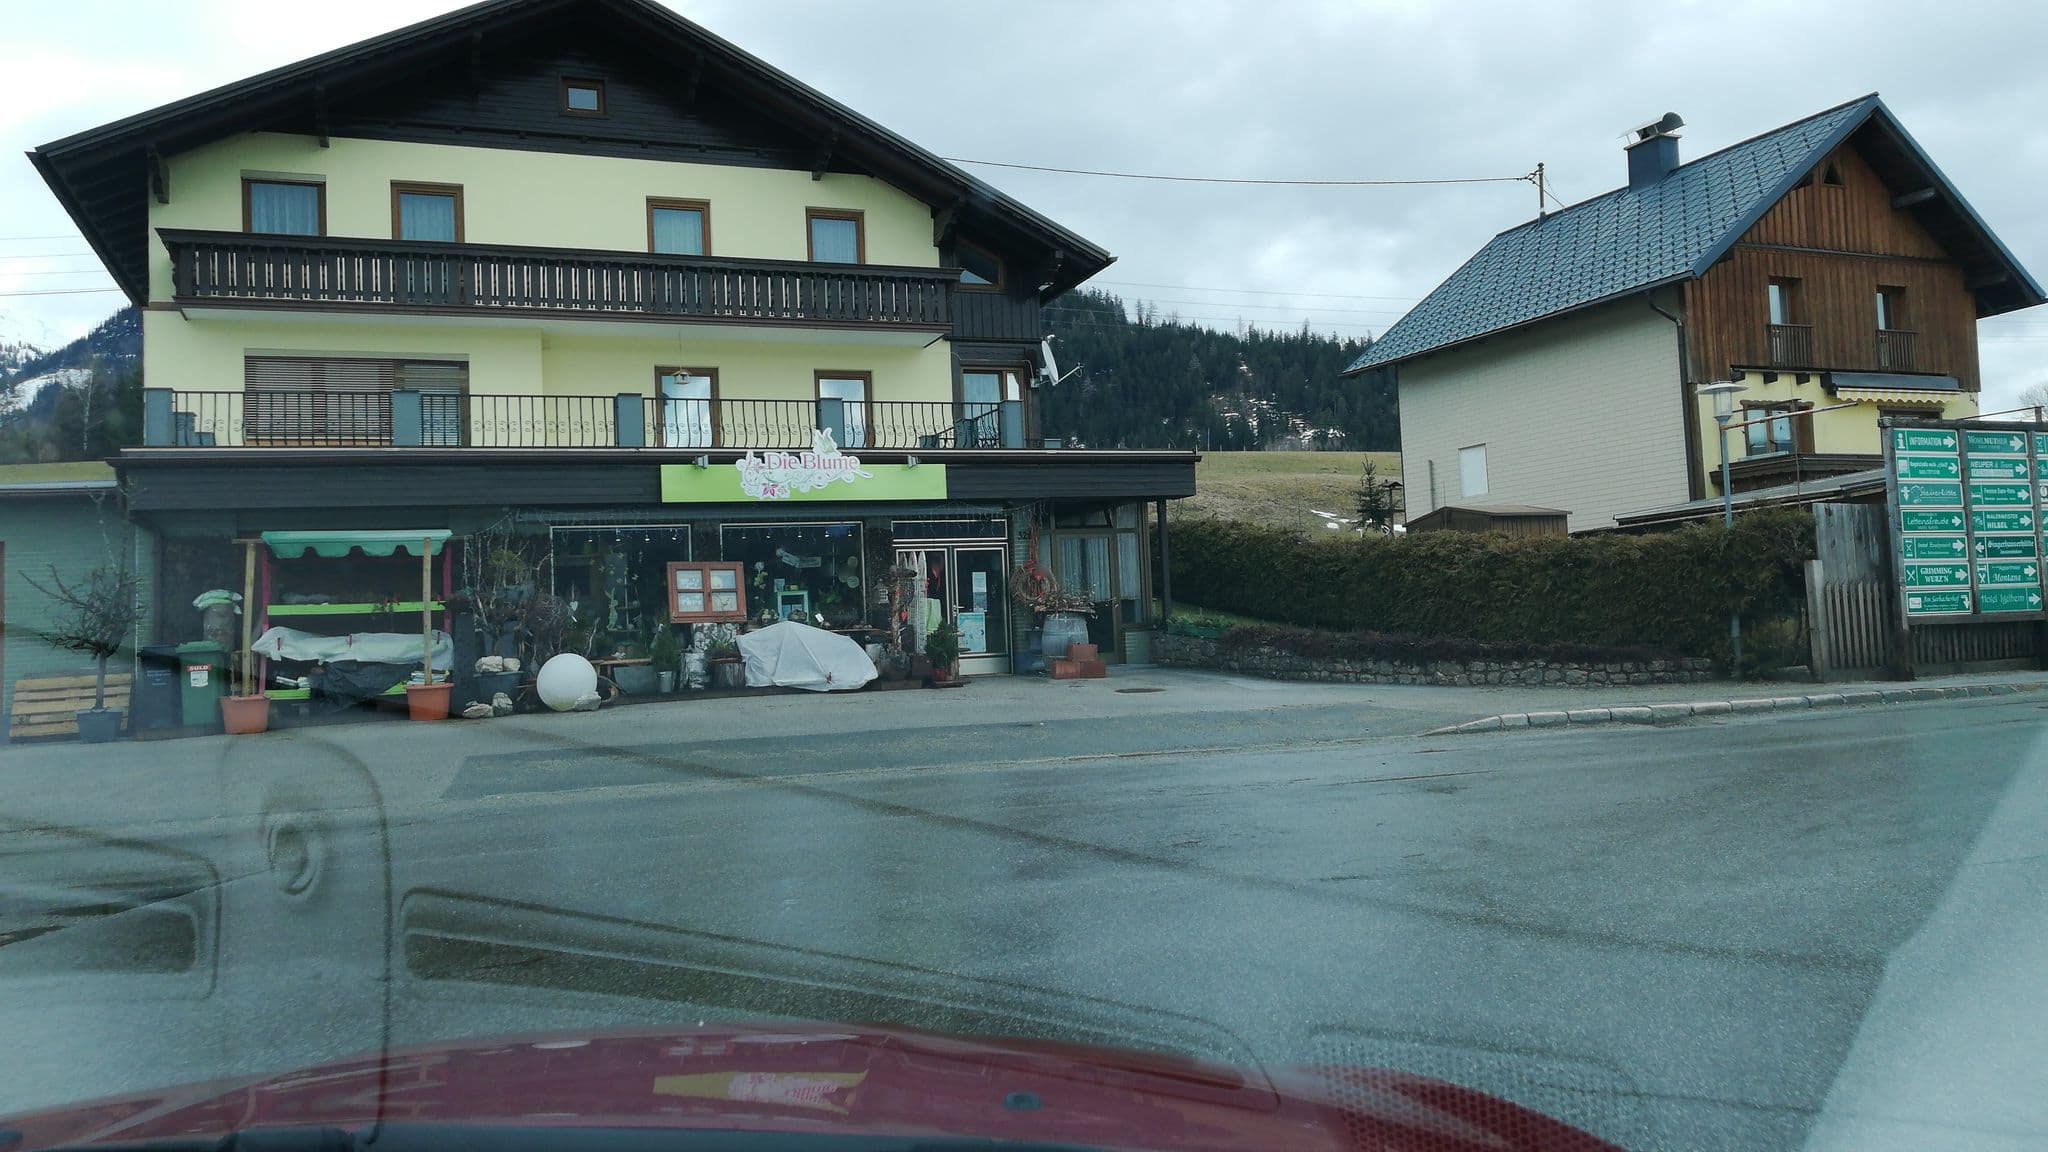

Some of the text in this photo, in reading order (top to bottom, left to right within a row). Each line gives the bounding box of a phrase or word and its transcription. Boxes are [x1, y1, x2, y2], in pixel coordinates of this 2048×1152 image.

[1908, 436, 1942, 446] INFORMATION
[767, 453, 858, 470] Die Blume
[1920, 567, 1952, 575] GRIMMING
